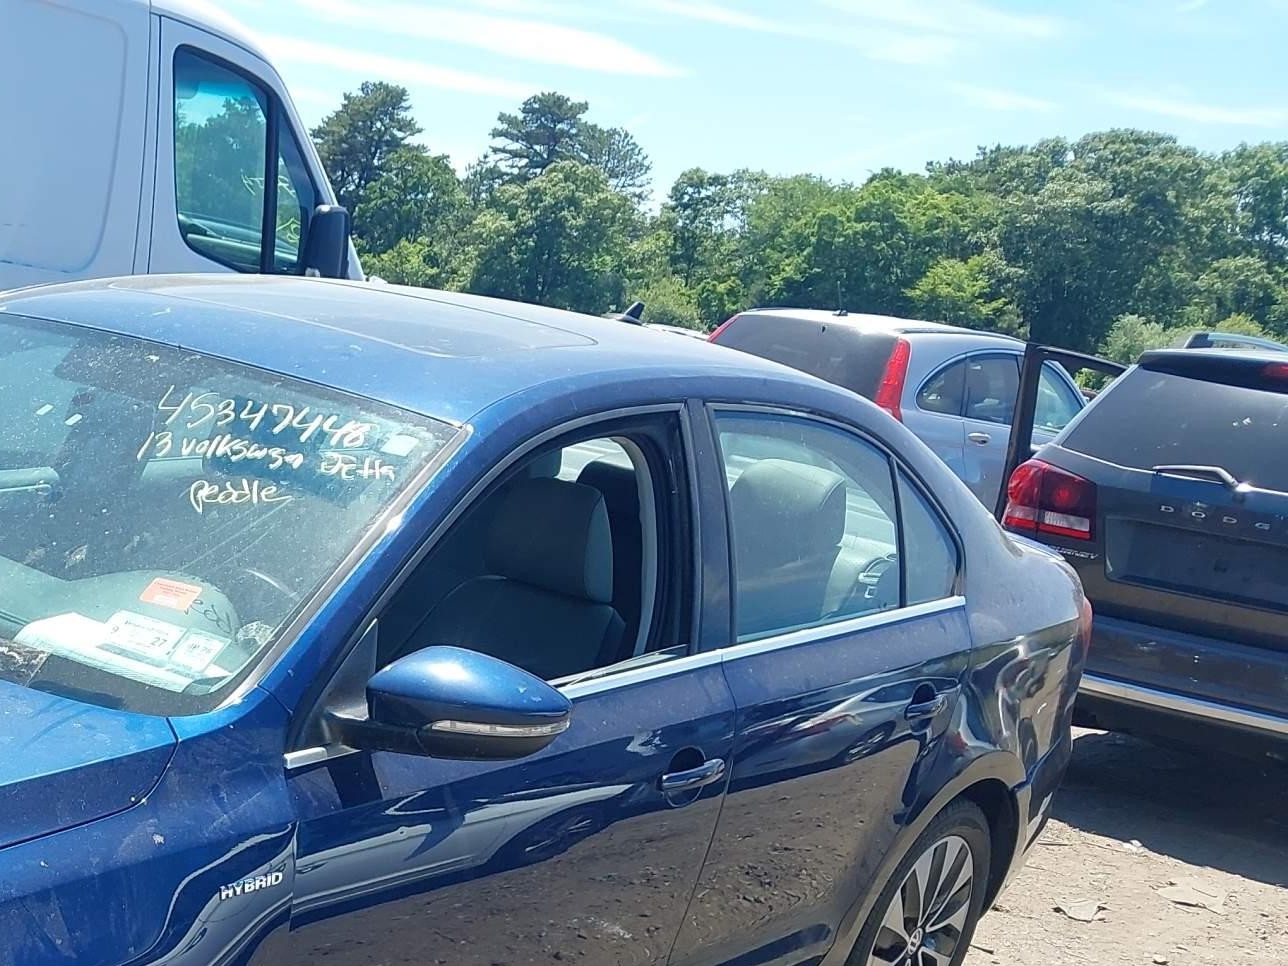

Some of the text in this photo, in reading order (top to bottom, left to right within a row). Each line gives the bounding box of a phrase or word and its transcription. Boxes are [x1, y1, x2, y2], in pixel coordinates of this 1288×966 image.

[158, 385, 372, 448] 45347448
[137, 432, 173, 461] 13
[220, 872, 283, 900] HYBRID
